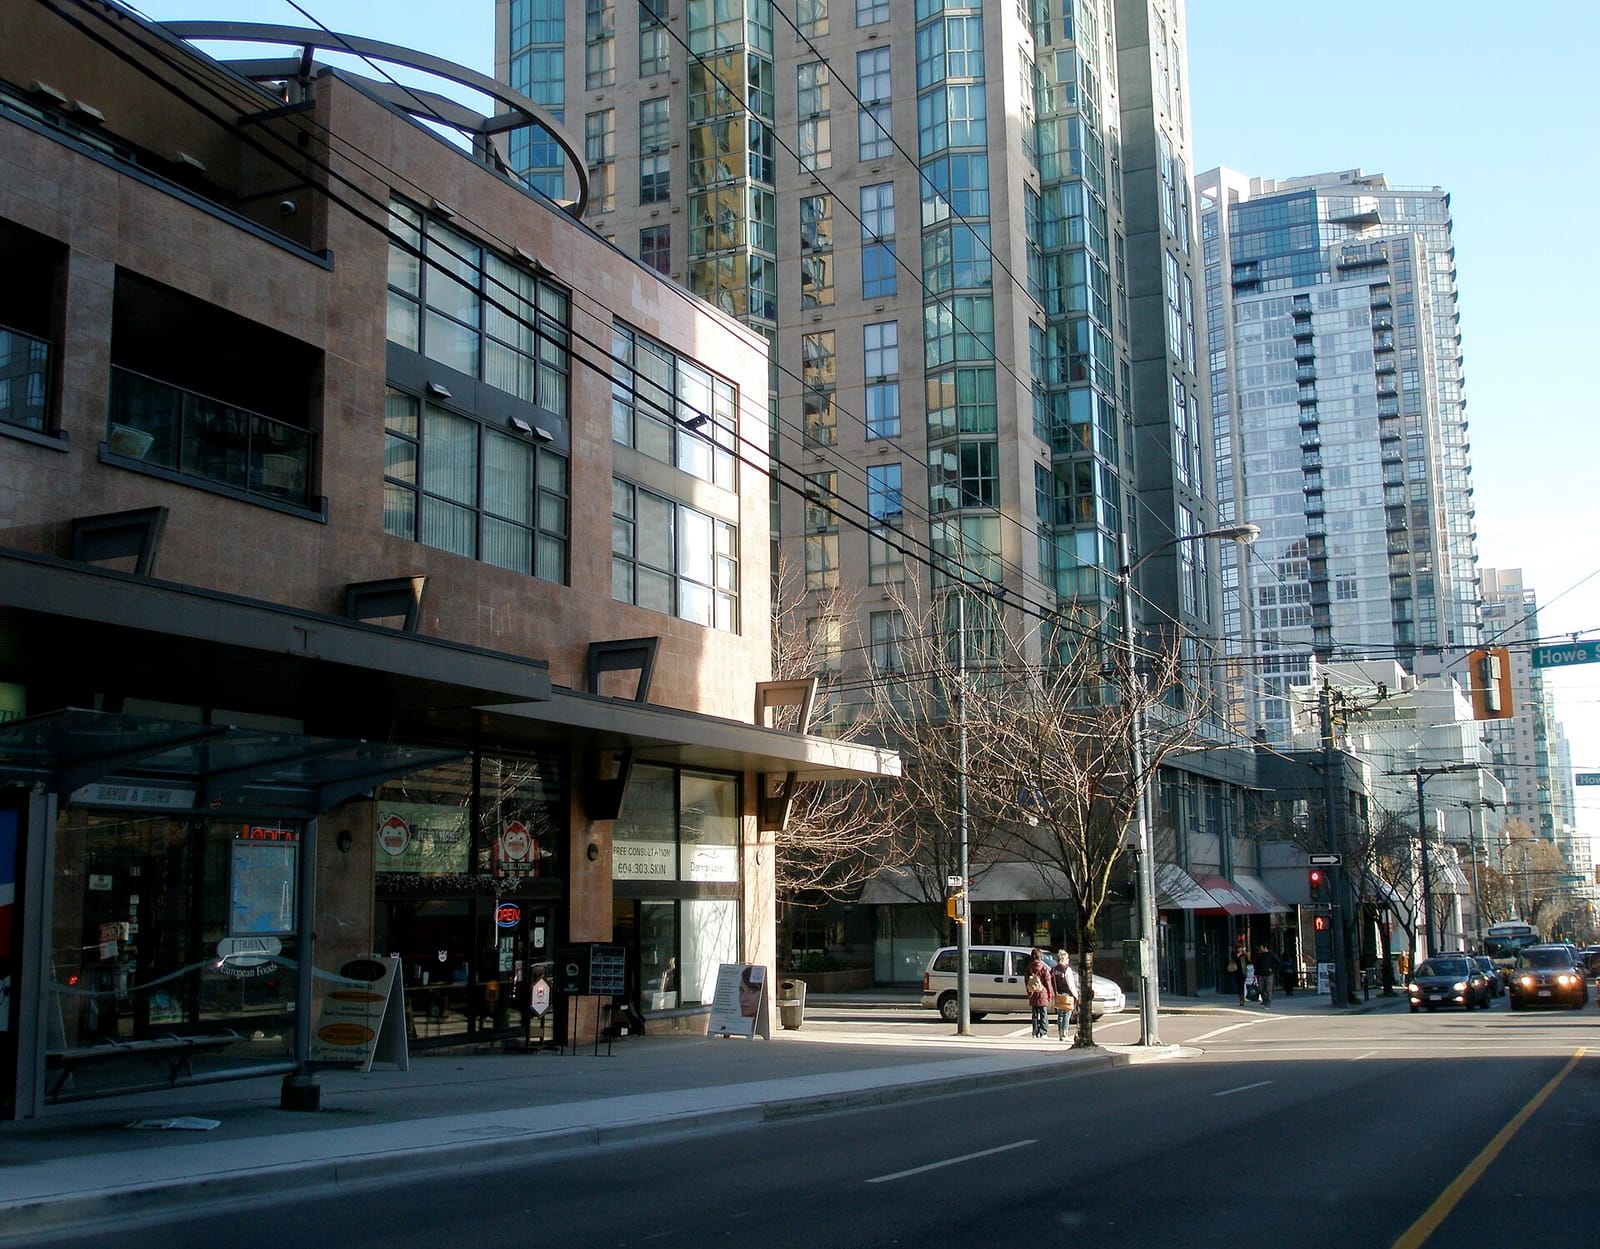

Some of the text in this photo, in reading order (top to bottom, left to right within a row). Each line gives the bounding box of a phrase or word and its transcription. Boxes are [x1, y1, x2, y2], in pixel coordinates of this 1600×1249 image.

[1539, 649, 1587, 665] Howe
[613, 846, 671, 857] FREE CONSULTATION
[618, 862, 666, 875] 604.303.SKIN
[497, 908, 520, 921] OPEN
[221, 962, 278, 980] European Foods
